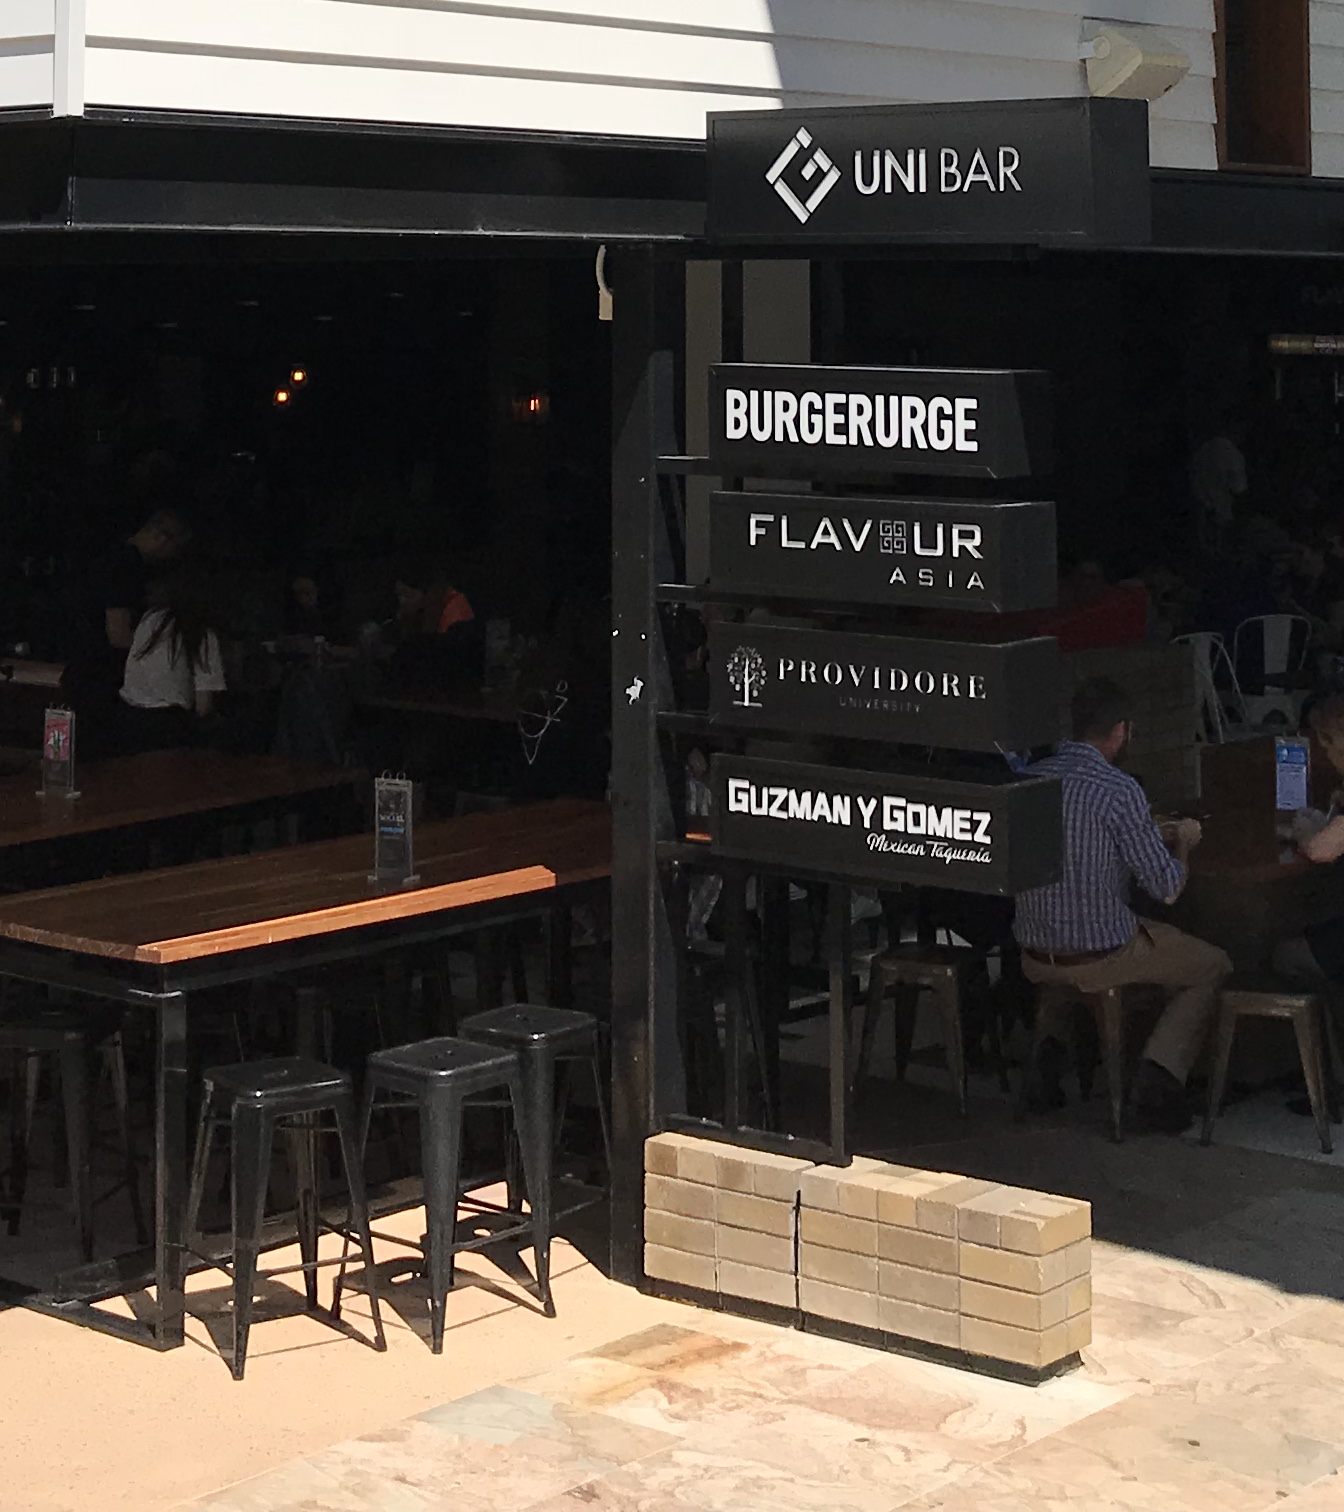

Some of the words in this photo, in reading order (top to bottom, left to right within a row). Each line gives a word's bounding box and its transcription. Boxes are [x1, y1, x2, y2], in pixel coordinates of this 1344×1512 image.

[855, 148, 927, 195] UNI
[940, 146, 1022, 193] BAR
[725, 388, 979, 452] BURGERURGE
[889, 566, 985, 590] ASIA
[777, 657, 988, 700] PROVIDORE
[838, 696, 921, 713] UNIVERSITY
[728, 778, 851, 826] GUZMAN
[856, 795, 878, 829] Y
[882, 795, 992, 845] GOMEZ
[866, 832, 926, 856] Mexican
